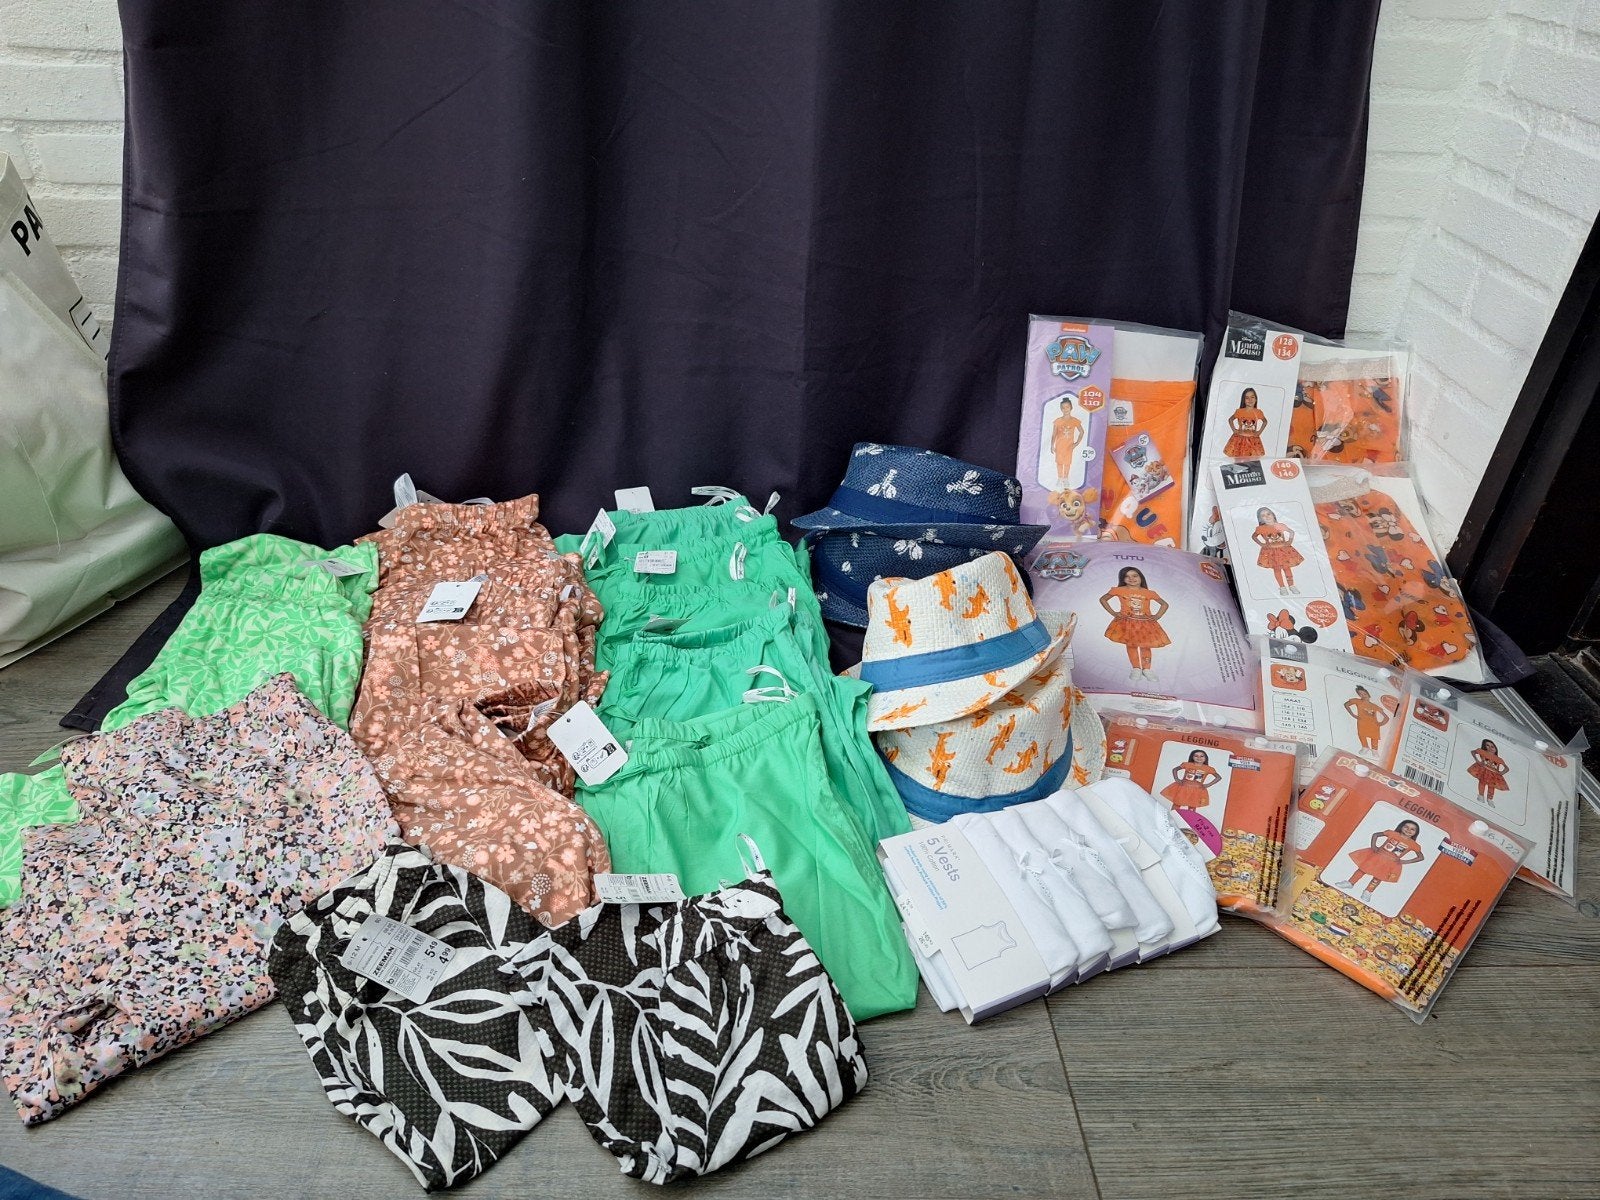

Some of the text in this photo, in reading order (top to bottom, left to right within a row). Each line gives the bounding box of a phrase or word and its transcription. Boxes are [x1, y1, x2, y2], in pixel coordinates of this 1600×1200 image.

[1046, 342, 1101, 365] PAW
[1278, 349, 1292, 357] 134
[1057, 364, 1085, 373] PATROL
[1335, 665, 1378, 682] LEGGING
[1181, 735, 1220, 748] LEGGING
[1399, 797, 1441, 824] LEGGING
[941, 835, 960, 860] PRIMARK
[927, 837, 960, 882] 5 Vests
[927, 854, 940, 872] Cotton
[372, 945, 394, 976] ZEEMAN
